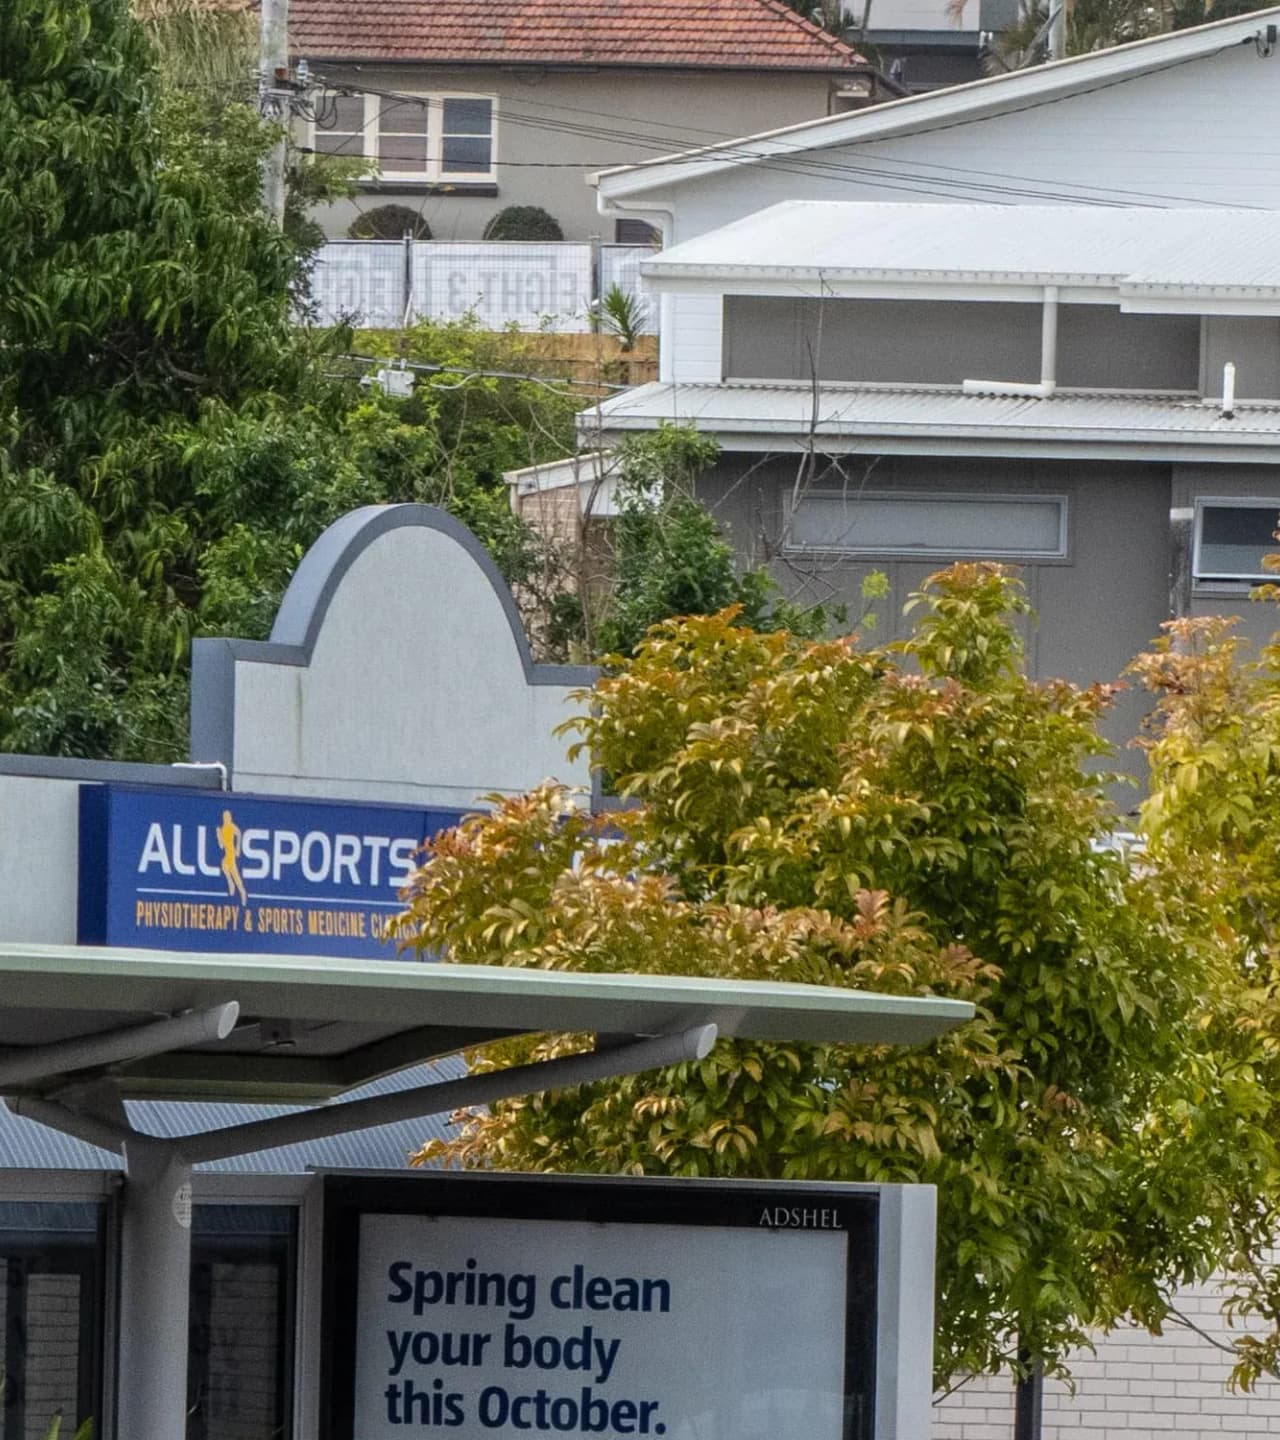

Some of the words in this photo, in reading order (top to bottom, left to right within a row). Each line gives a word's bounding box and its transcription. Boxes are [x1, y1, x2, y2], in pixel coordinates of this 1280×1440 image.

[136, 901, 240, 931] PHYSIOTHERAPY
[244, 913, 253, 932] &
[257, 907, 303, 935] SPORTS
[308, 910, 367, 938] MEDICINE
[758, 1206, 843, 1229] ADSHEL
[387, 1259, 537, 1320] Spring
[549, 1264, 672, 1313] clean
[385, 1329, 490, 1375] your
[503, 1324, 621, 1384] body
[384, 1379, 465, 1427] this
[476, 1384, 667, 1435] October.
